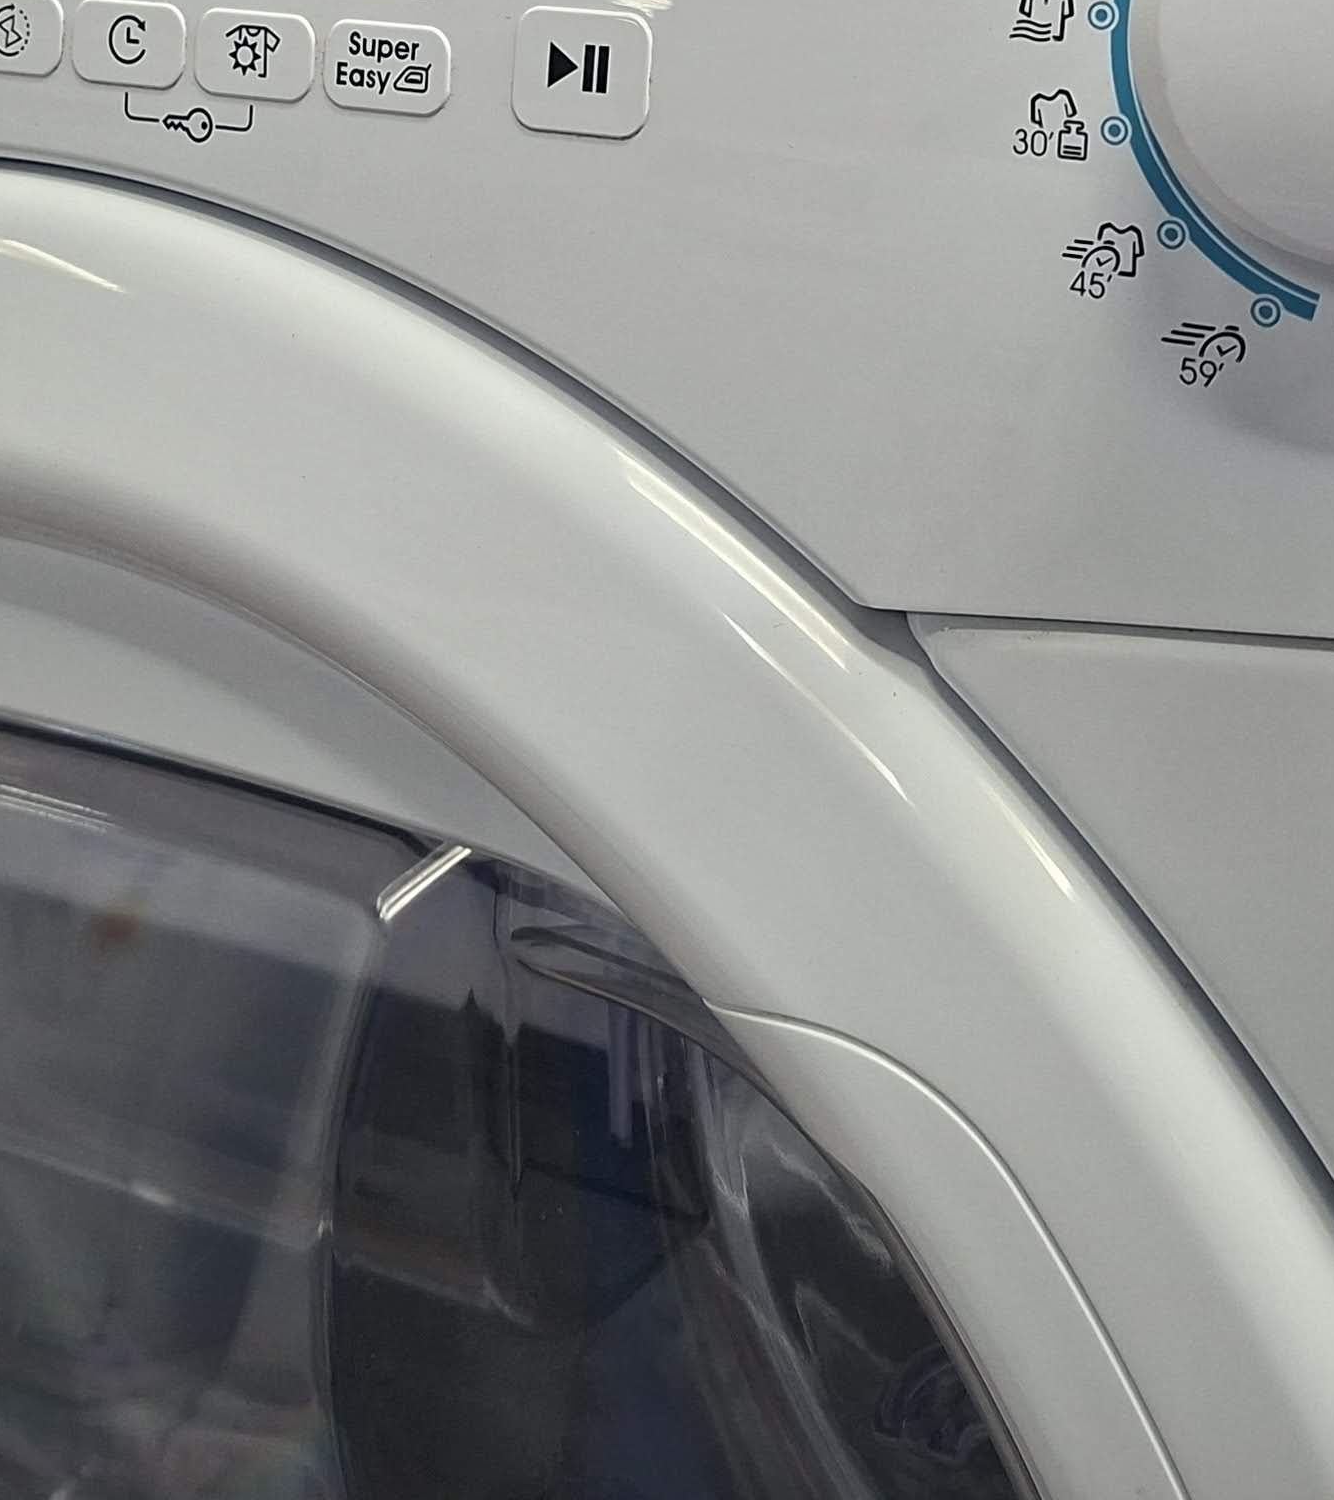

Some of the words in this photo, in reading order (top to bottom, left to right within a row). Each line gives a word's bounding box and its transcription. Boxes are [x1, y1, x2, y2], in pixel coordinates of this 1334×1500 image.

[348, 31, 420, 63] Super
[335, 61, 391, 95] Easy
[1012, 128, 1055, 157] 30'
[1069, 270, 1113, 300] 45'
[1178, 356, 1225, 388] 59'
